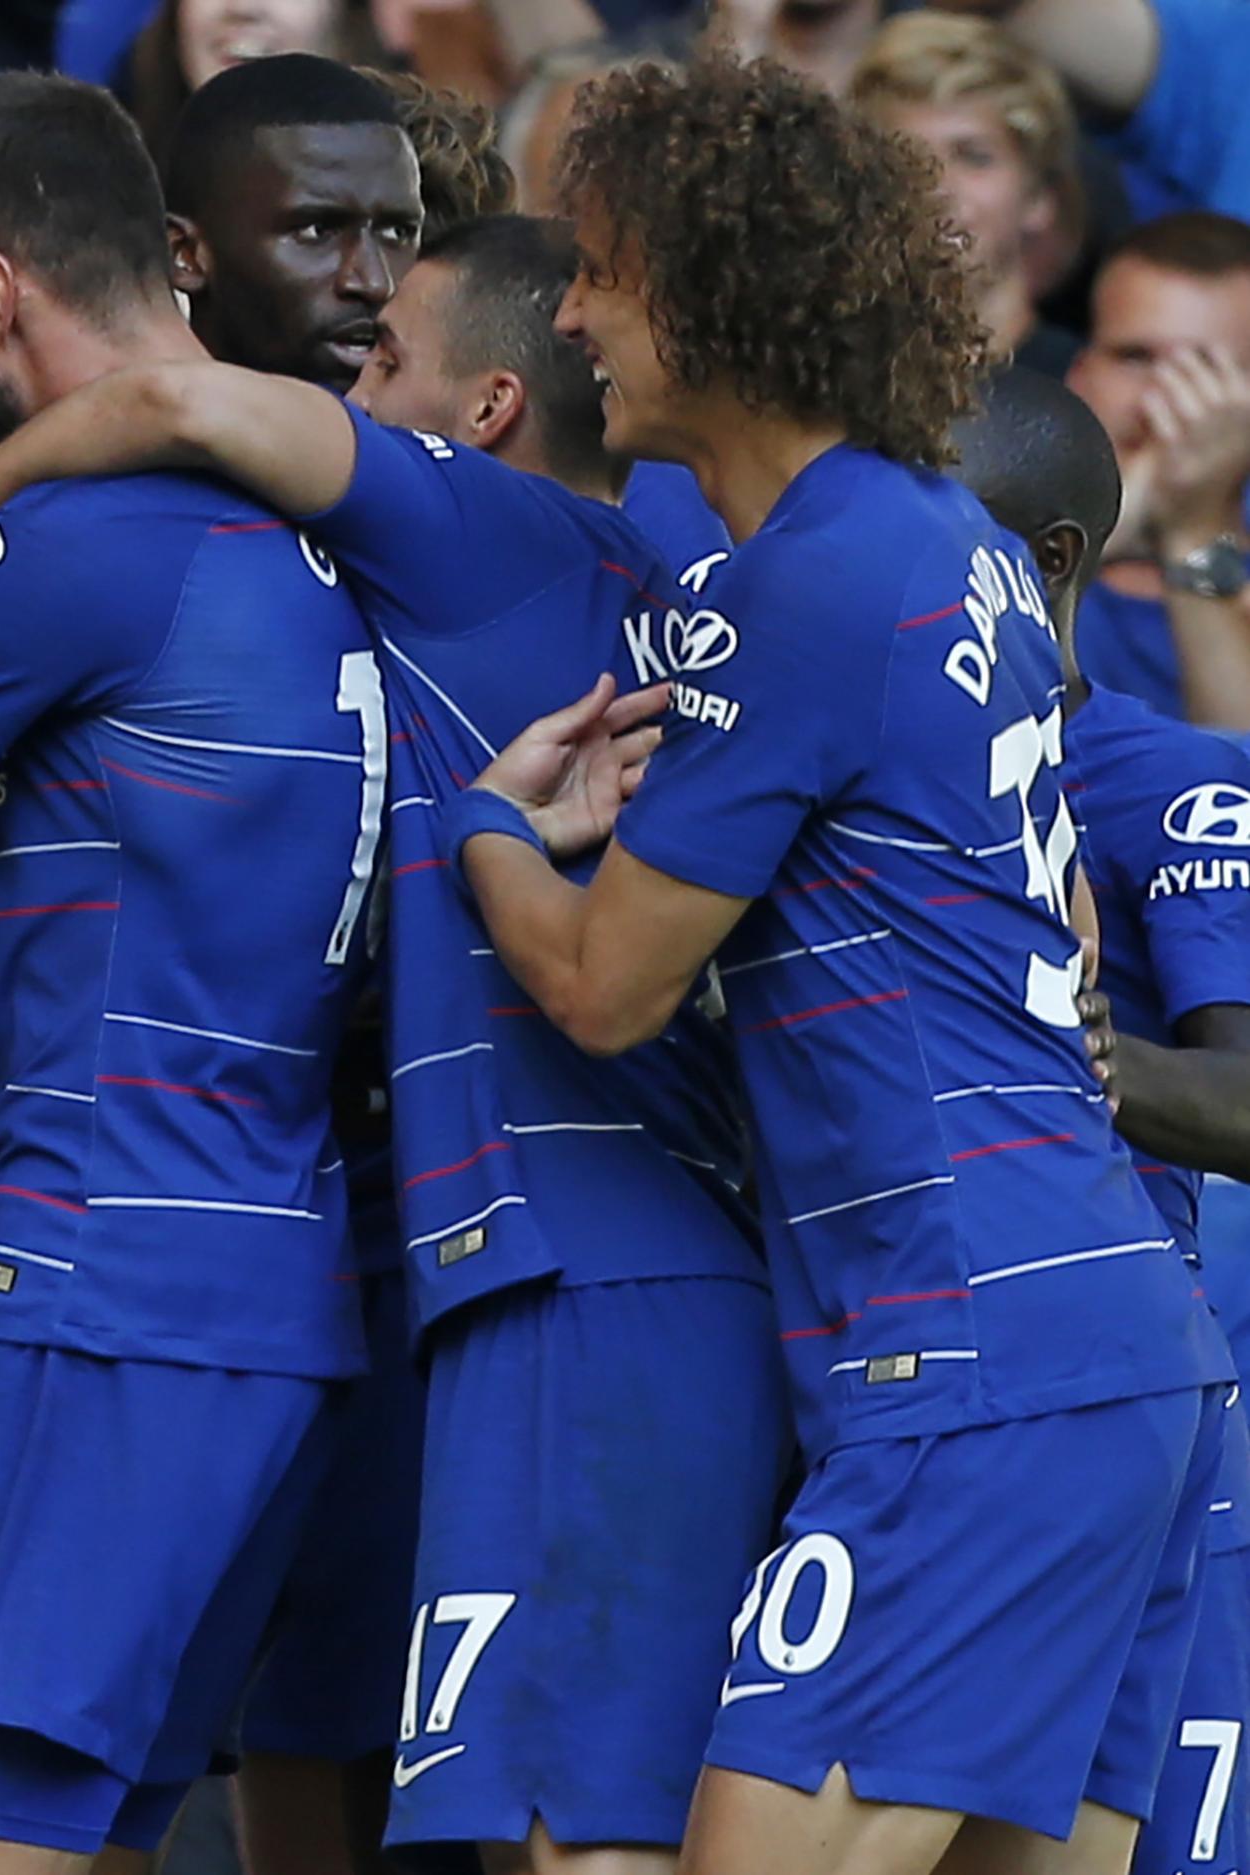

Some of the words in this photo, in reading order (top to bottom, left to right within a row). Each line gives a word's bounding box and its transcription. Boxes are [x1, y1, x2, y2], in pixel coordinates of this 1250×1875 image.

[1149, 859, 1250, 900] HYUN
[400, 1592, 517, 1742] 17
[1179, 1719, 1242, 1862] 7
